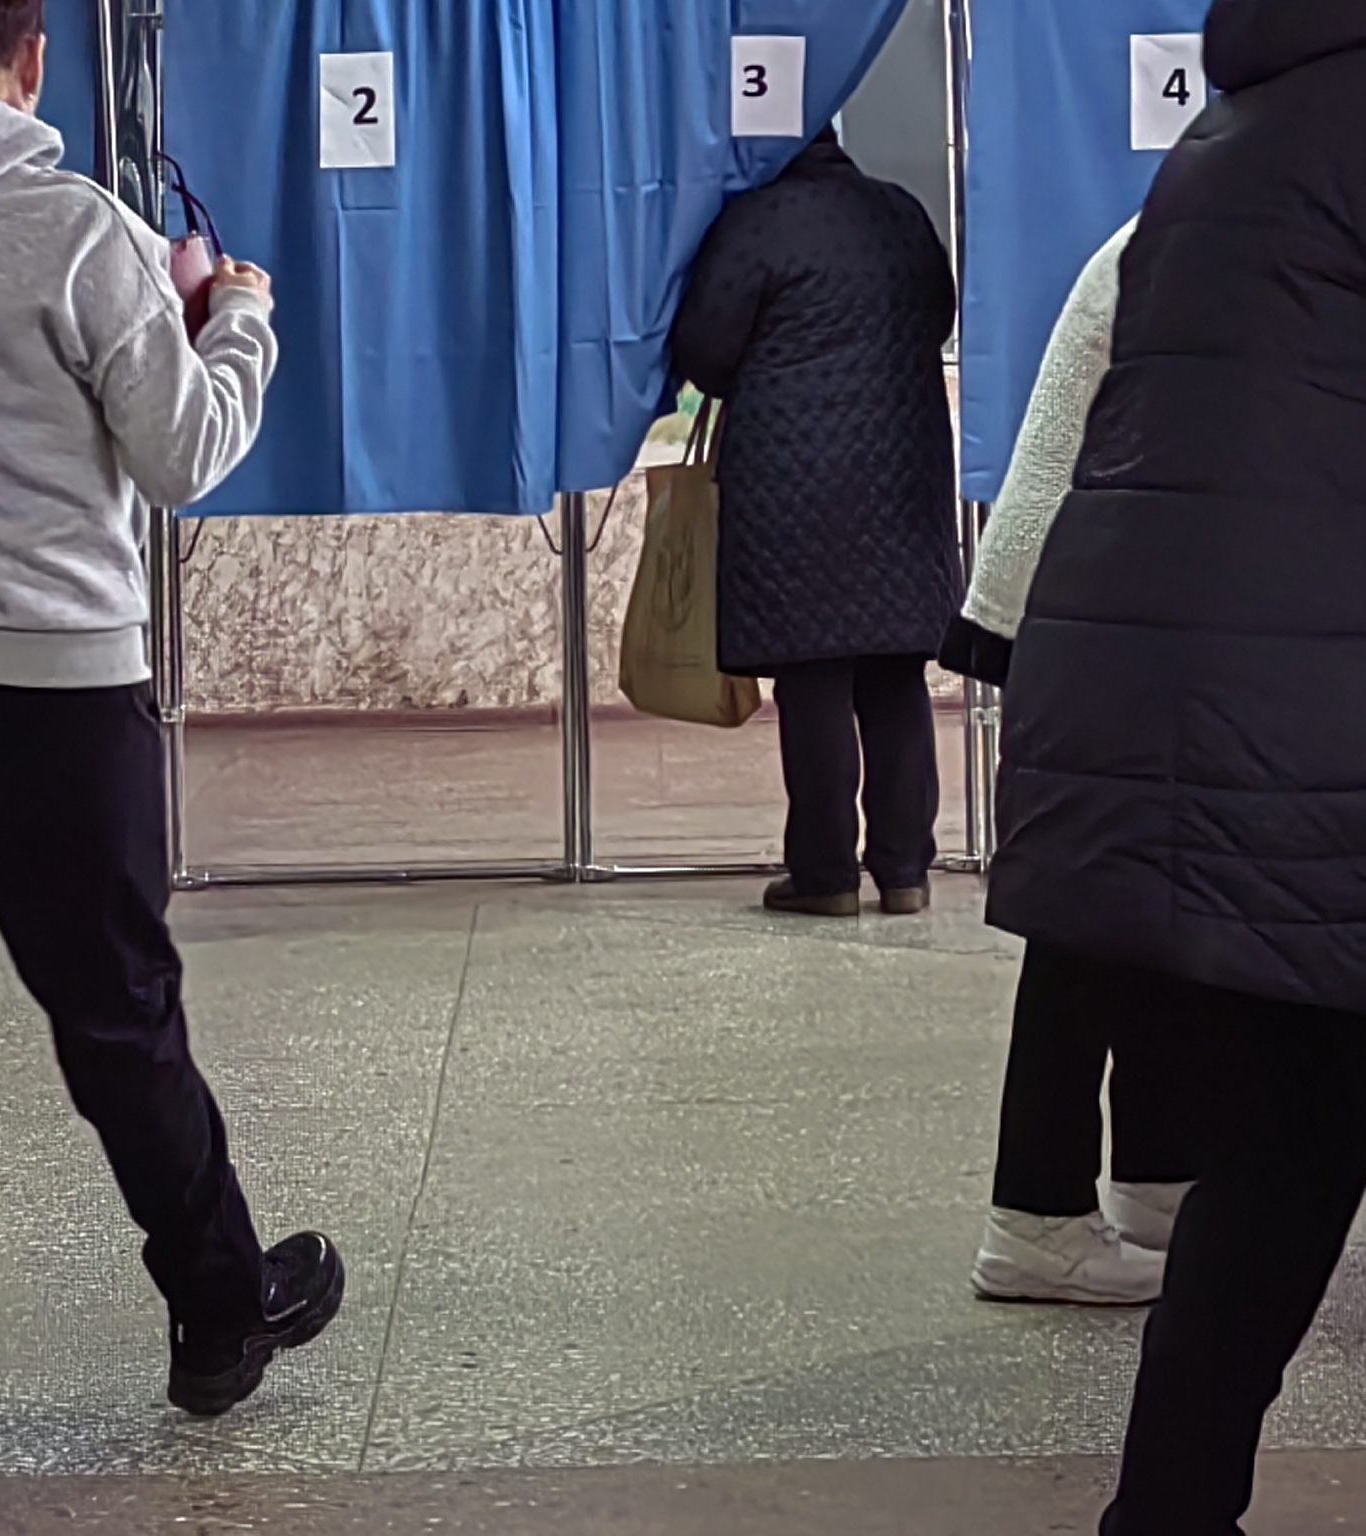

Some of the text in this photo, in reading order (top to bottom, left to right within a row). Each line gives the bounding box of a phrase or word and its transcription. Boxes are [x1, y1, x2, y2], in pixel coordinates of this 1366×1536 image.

[742, 64, 768, 97] 3
[1162, 68, 1190, 106] 4
[352, 86, 378, 125] 2
